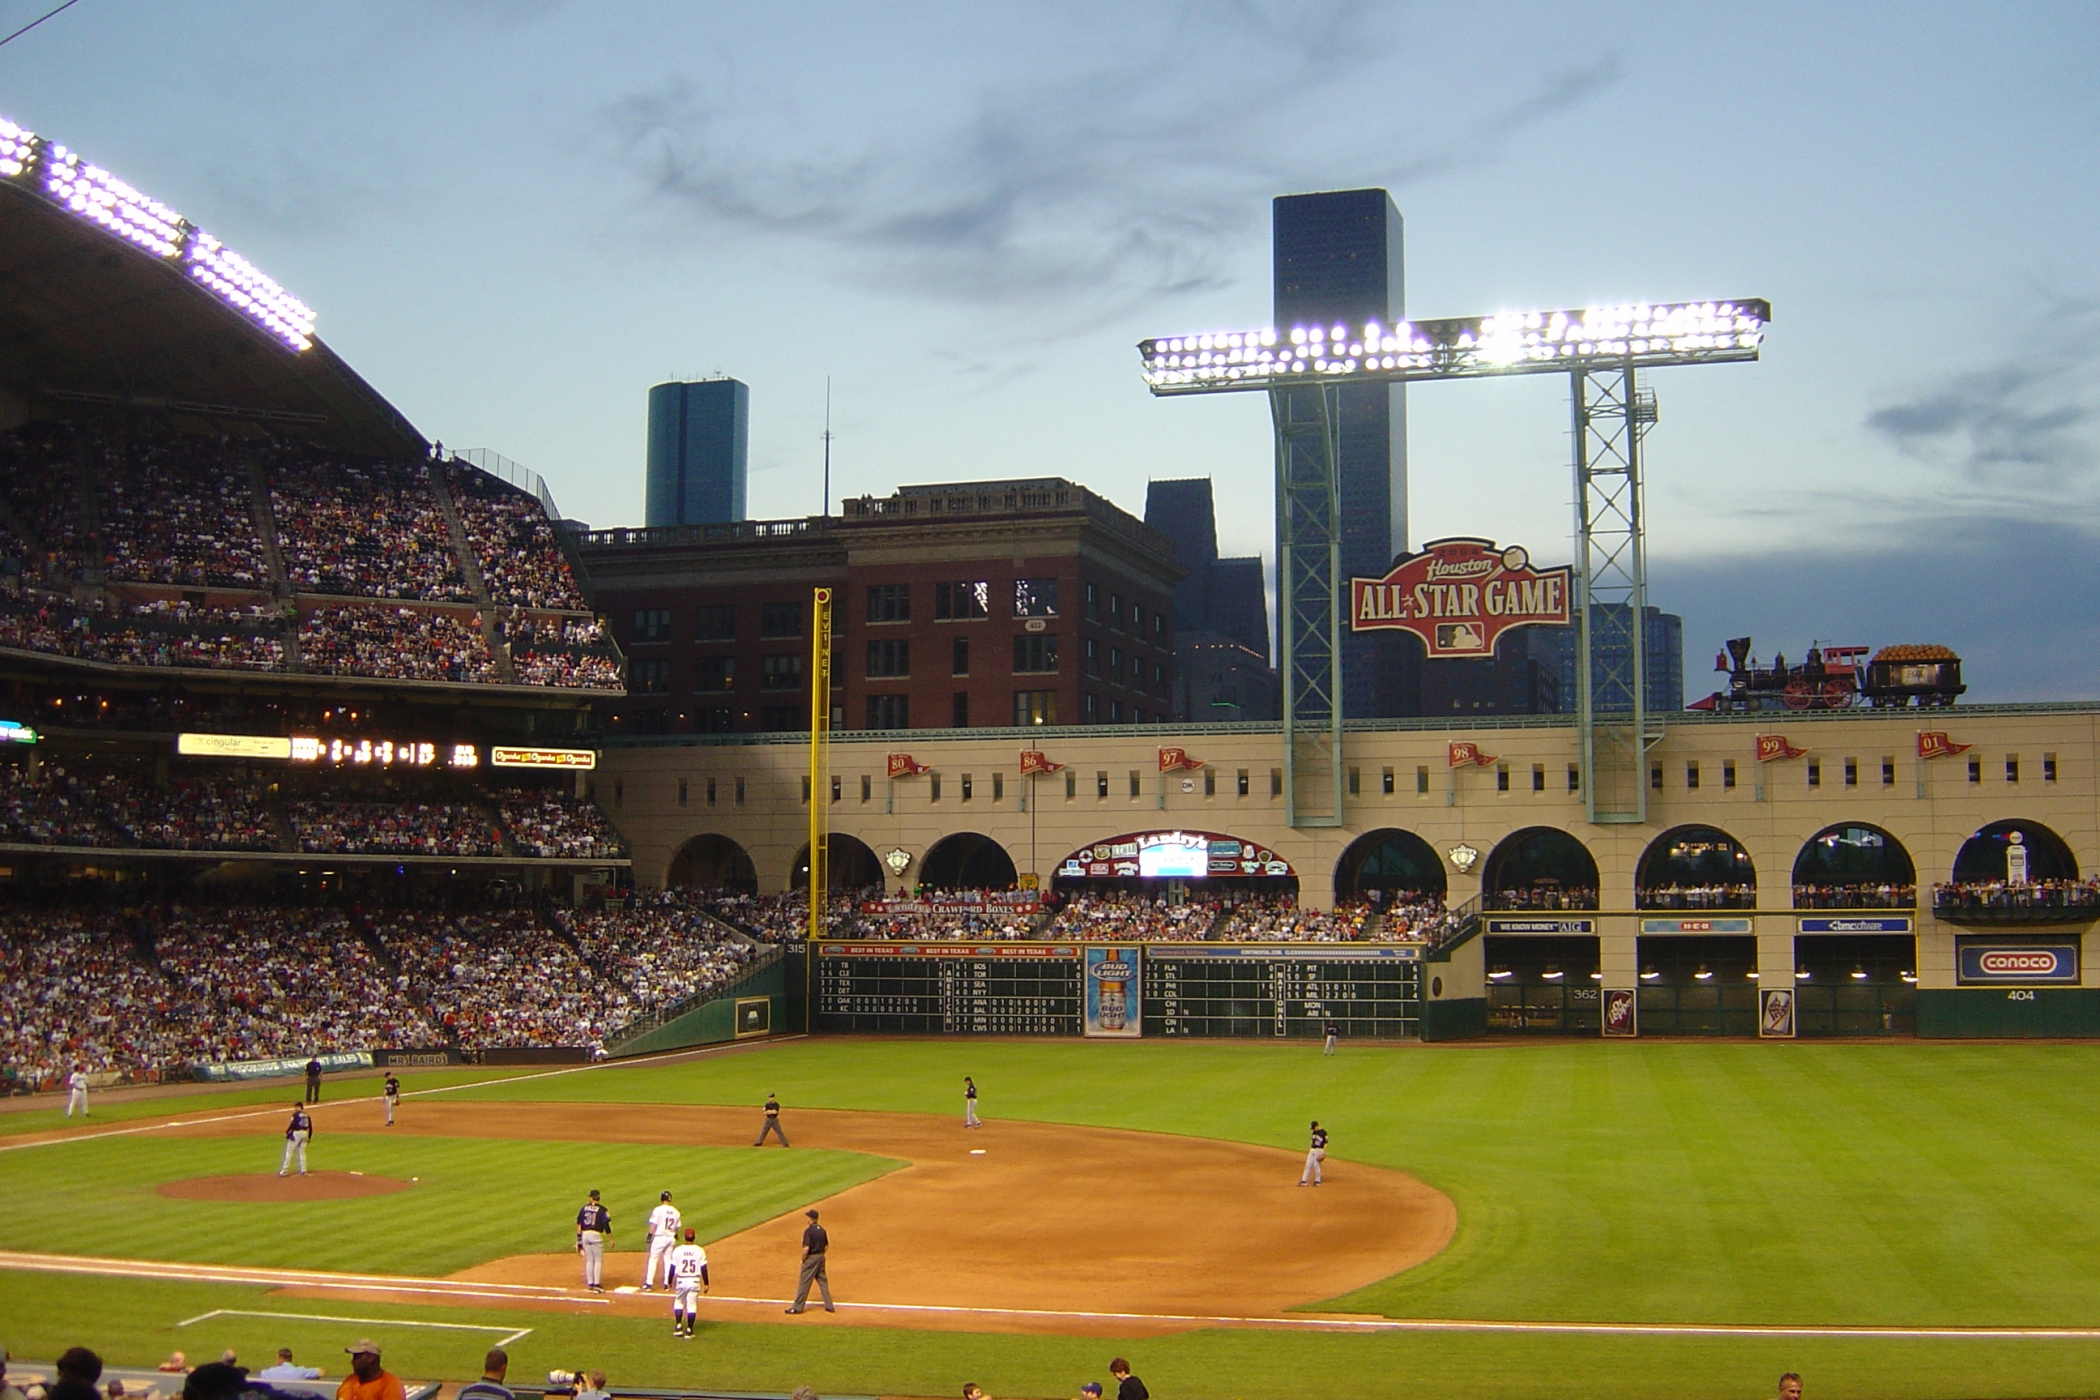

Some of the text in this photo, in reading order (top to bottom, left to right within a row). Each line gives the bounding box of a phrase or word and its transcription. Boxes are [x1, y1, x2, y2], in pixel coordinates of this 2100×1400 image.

[1427, 559, 1492, 580] Houston
[1484, 577, 1562, 616] GAME
[206, 738, 241, 747] cingular
[1763, 741, 1778, 752] 99
[1923, 737, 1938, 749] 01
[1164, 752, 1177, 764] 97
[1454, 747, 1469, 759] 98
[891, 758, 904, 769] 80
[1024, 756, 1036, 767] 86
[1135, 831, 1208, 850] Landry's
[933, 904, 982, 913] CRAWFRD
[986, 904, 1014, 914] BOXES
[1559, 922, 1581, 931] AIG
[788, 944, 805, 953] 315
[1574, 990, 1597, 999] 362
[2007, 991, 2035, 1000] 404
[333, 1053, 357, 1065] SALES
[583, 1211, 596, 1225] 31
[665, 1217, 675, 1230] 12
[682, 1259, 696, 1273] 25
